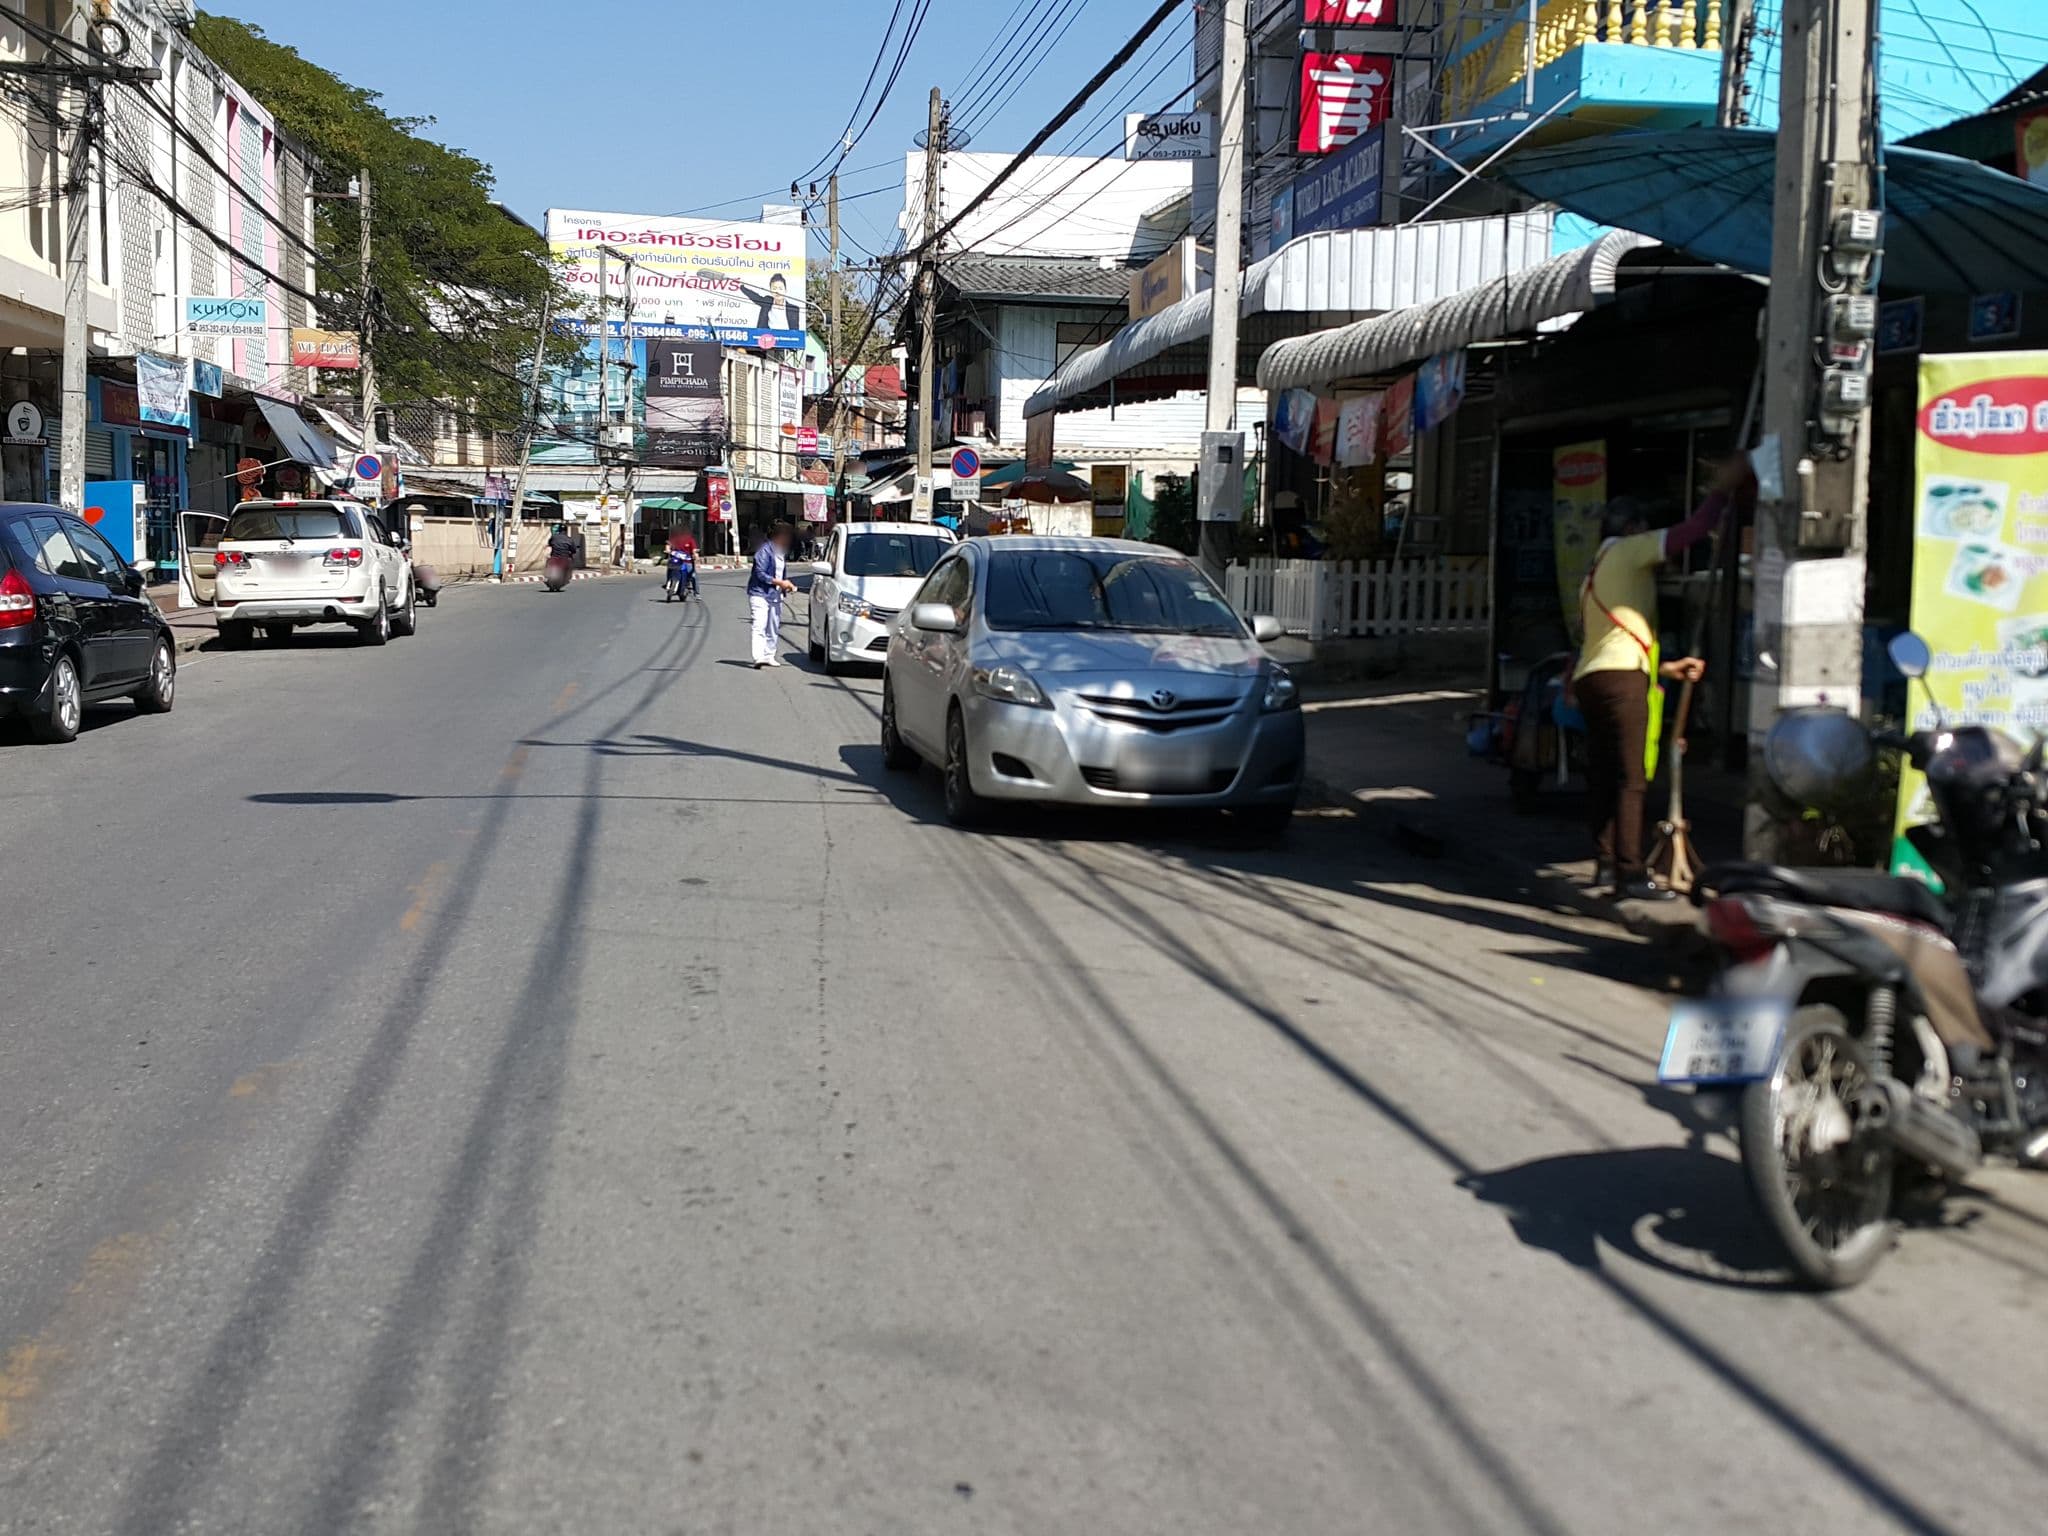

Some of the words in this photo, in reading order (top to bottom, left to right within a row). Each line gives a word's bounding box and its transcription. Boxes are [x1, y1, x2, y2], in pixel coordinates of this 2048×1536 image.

[563, 215, 602, 226] โครงการ
[192, 303, 259, 318] KUMON
[660, 376, 709, 386] PIMPICHADA
